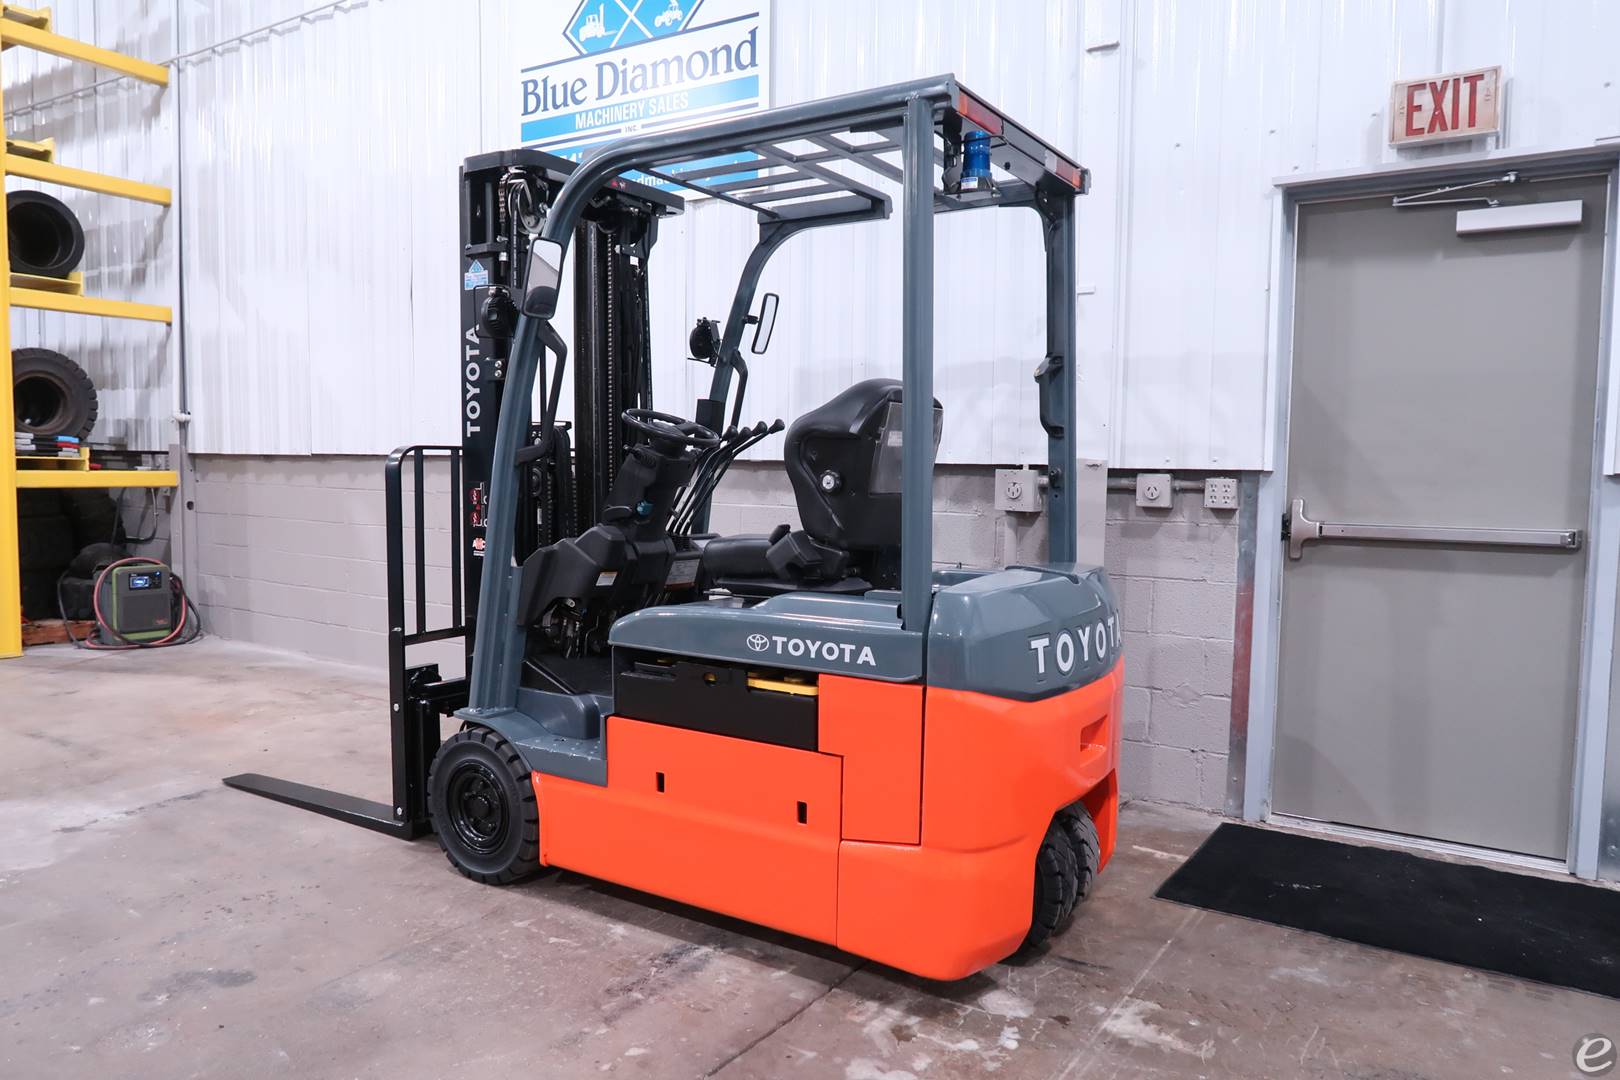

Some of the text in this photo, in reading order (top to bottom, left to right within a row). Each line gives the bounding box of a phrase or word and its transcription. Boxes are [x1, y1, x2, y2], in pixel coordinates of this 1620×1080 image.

[521, 25, 759, 116] Blue Diamond
[575, 91, 689, 130] MACHINERY SALES
[1406, 73, 1485, 137] EXIT
[466, 323, 481, 438] TOYOTA
[772, 635, 877, 667] TOYOTA
